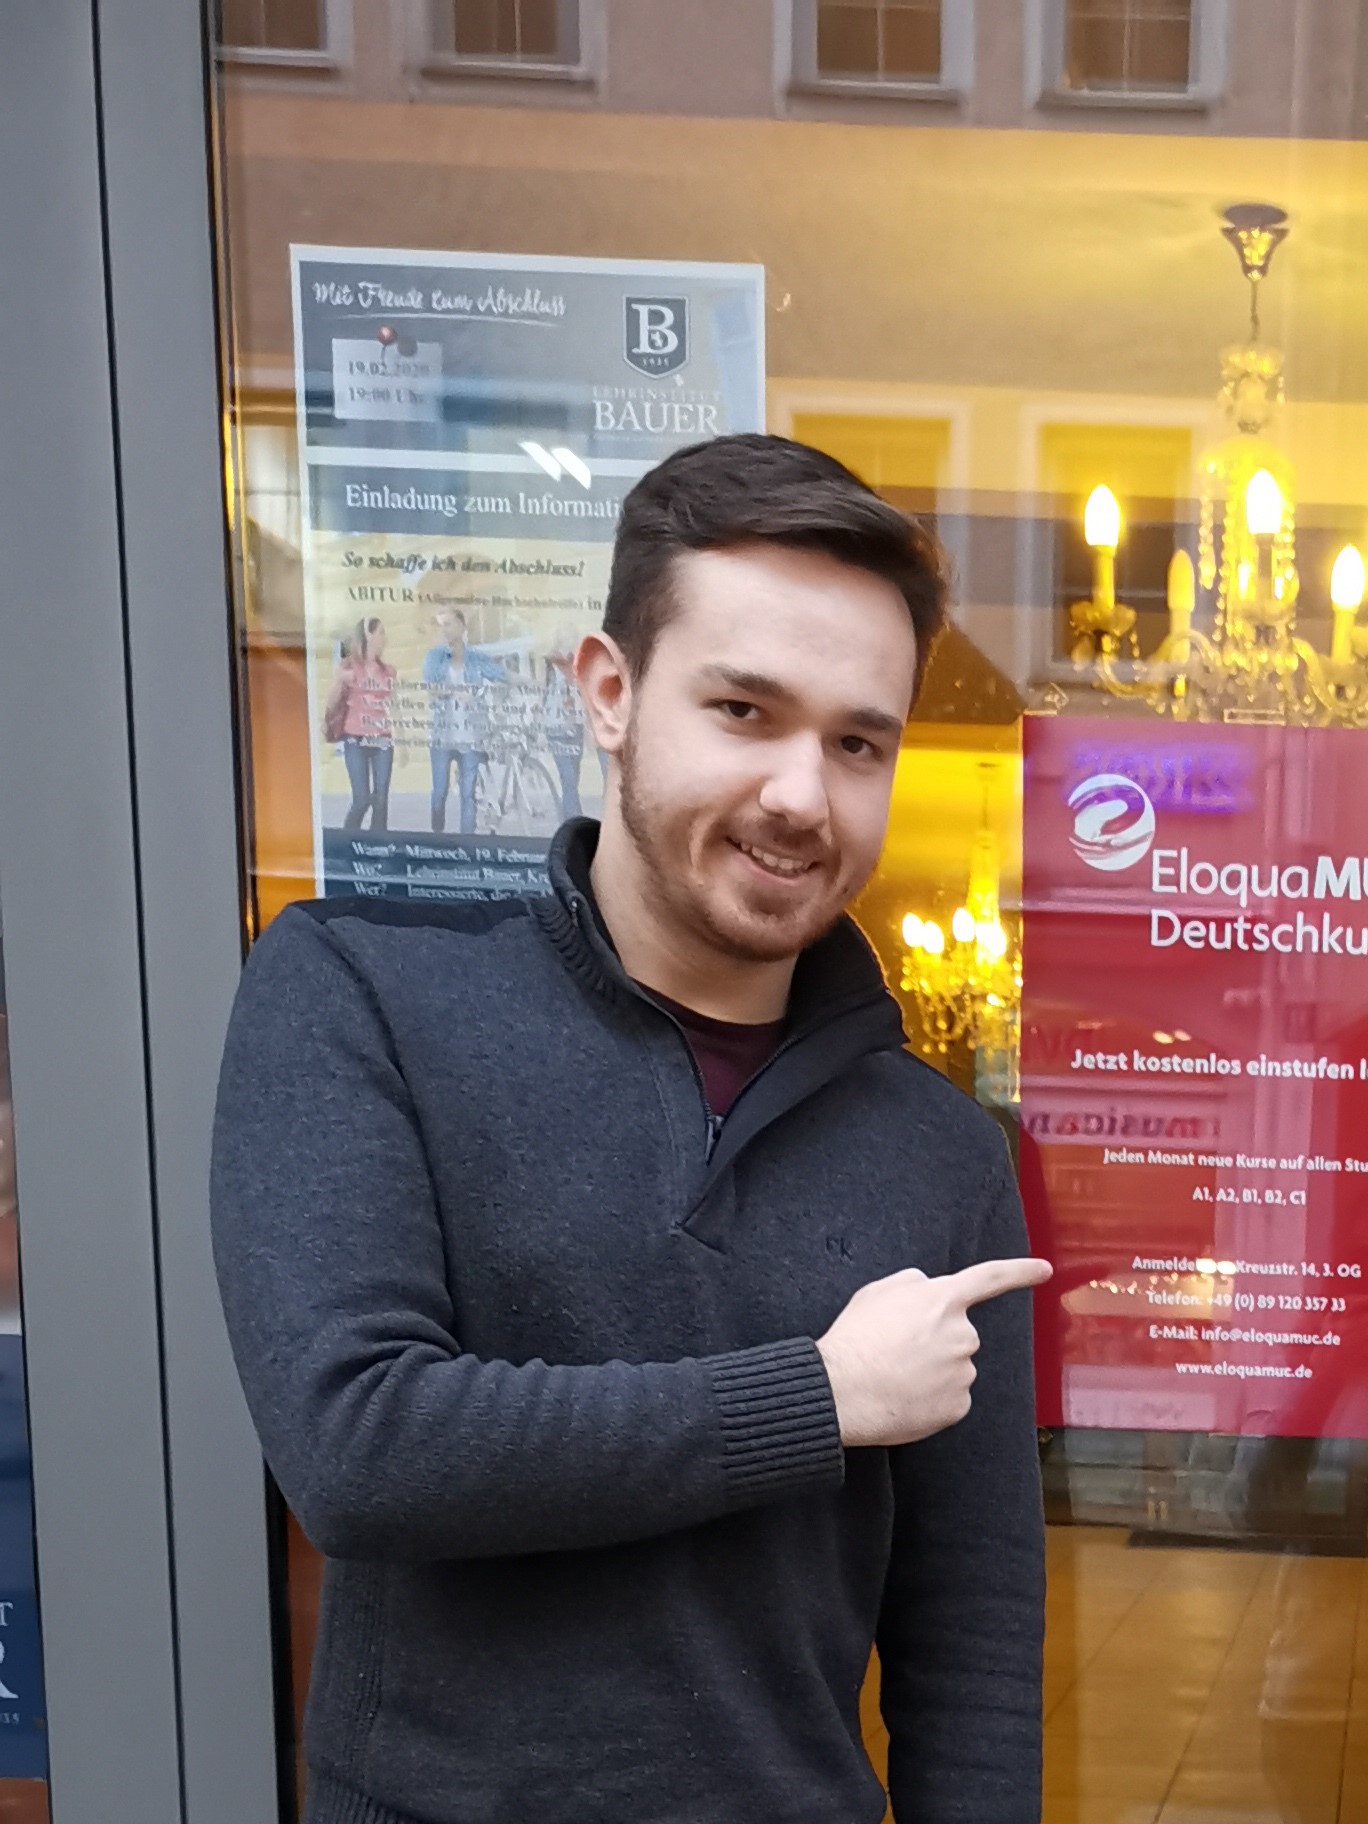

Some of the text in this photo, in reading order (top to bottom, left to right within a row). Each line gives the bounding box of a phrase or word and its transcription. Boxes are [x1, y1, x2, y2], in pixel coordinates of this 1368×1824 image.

[312, 281, 354, 306] Mit
[478, 284, 567, 317] Abschluss
[631, 303, 679, 355] B
[592, 399, 721, 435] BAUER
[346, 483, 623, 519] Einladung zum Informati
[341, 551, 363, 569] So
[368, 553, 428, 575] schaffe
[430, 553, 456, 573] ich
[494, 558, 586, 578] Abschluss!
[348, 586, 415, 603] ABITUR
[1070, 1048, 1128, 1072] Jetzt
[1133, 1049, 1242, 1077] kostenlos
[1246, 1053, 1354, 1080] einstufen
[1103, 1147, 1145, 1165] Jeden
[1148, 1149, 1195, 1167] Monat
[1198, 1153, 1233, 1168] neue
[1236, 1153, 1277, 1170] Kurse
[1280, 1154, 1305, 1171] auf
[1306, 1156, 1342, 1172] allen
[1192, 1186, 1307, 1206] A1, A2, B1, B2, C1
[1132, 1255, 1362, 1279] Anmelde Kreuzstr. 14, 3. OG
[1146, 1290, 1201, 1307] Telefon:
[1234, 1292, 1254, 1313] (0)
[1257, 1295, 1275, 1310] 89
[1279, 1295, 1302, 1311] 120
[1304, 1296, 1328, 1312] 357
[1330, 1297, 1346, 1313] 33
[1149, 1324, 1341, 1347] E-Mail: info@eloquamuc.de
[1175, 1360, 1313, 1380] www.eloquamuc.de
